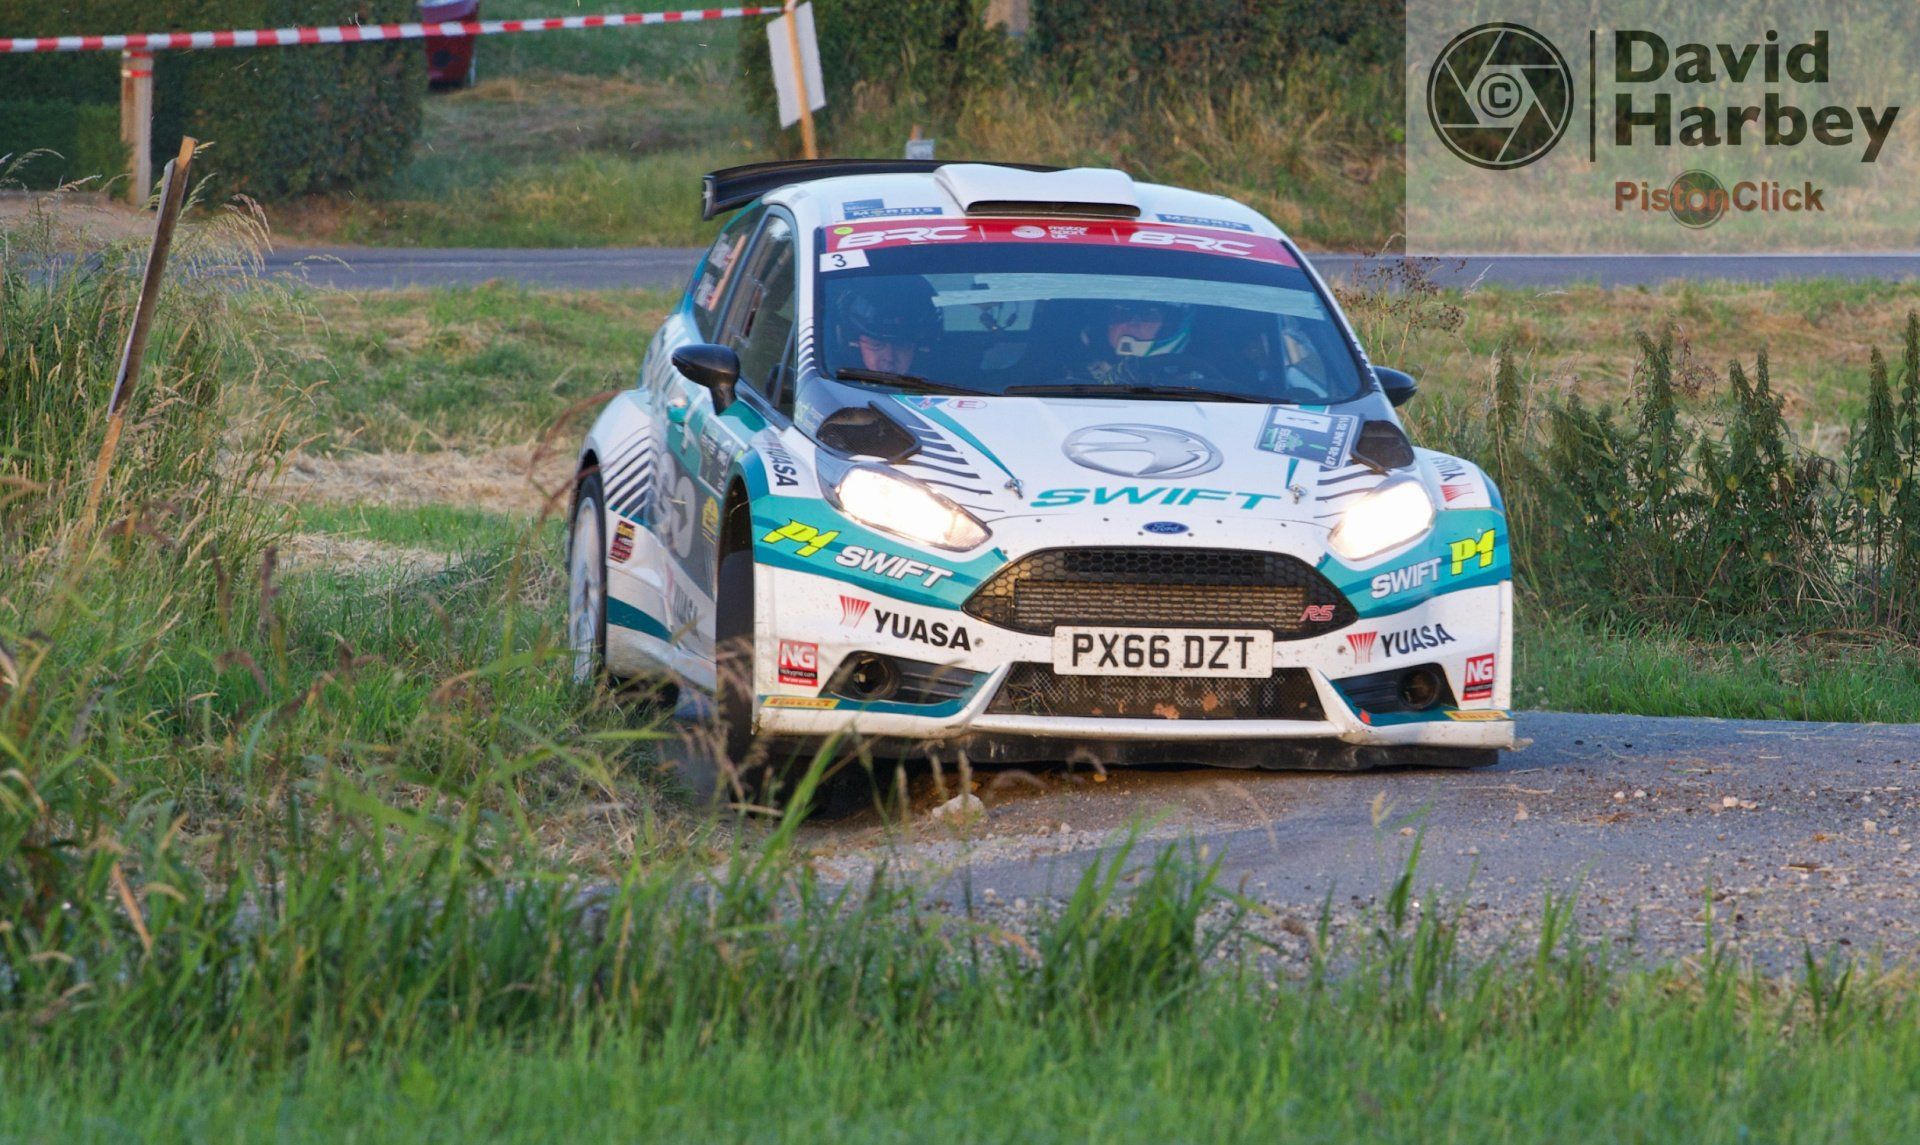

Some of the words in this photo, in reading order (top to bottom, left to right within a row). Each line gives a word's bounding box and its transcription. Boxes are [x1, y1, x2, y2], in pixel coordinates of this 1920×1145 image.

[837, 226, 973, 250] BRC
[1129, 231, 1256, 256] BRC
[831, 254, 847, 268] 3
[1030, 486, 1281, 510] SWIFT
[762, 518, 841, 557] P1
[1152, 522, 1181, 533] Ford
[1449, 528, 1496, 576] P1
[835, 545, 953, 589] SWIFT
[1371, 557, 1442, 599] SWIFT
[1300, 605, 1335, 623] RS
[874, 608, 972, 651] YUASA
[1380, 623, 1457, 658] YUASA
[781, 643, 816, 669] NG
[1071, 633, 1170, 669] PX66
[1183, 636, 1255, 670] DZT
[1467, 658, 1493, 683] NG
